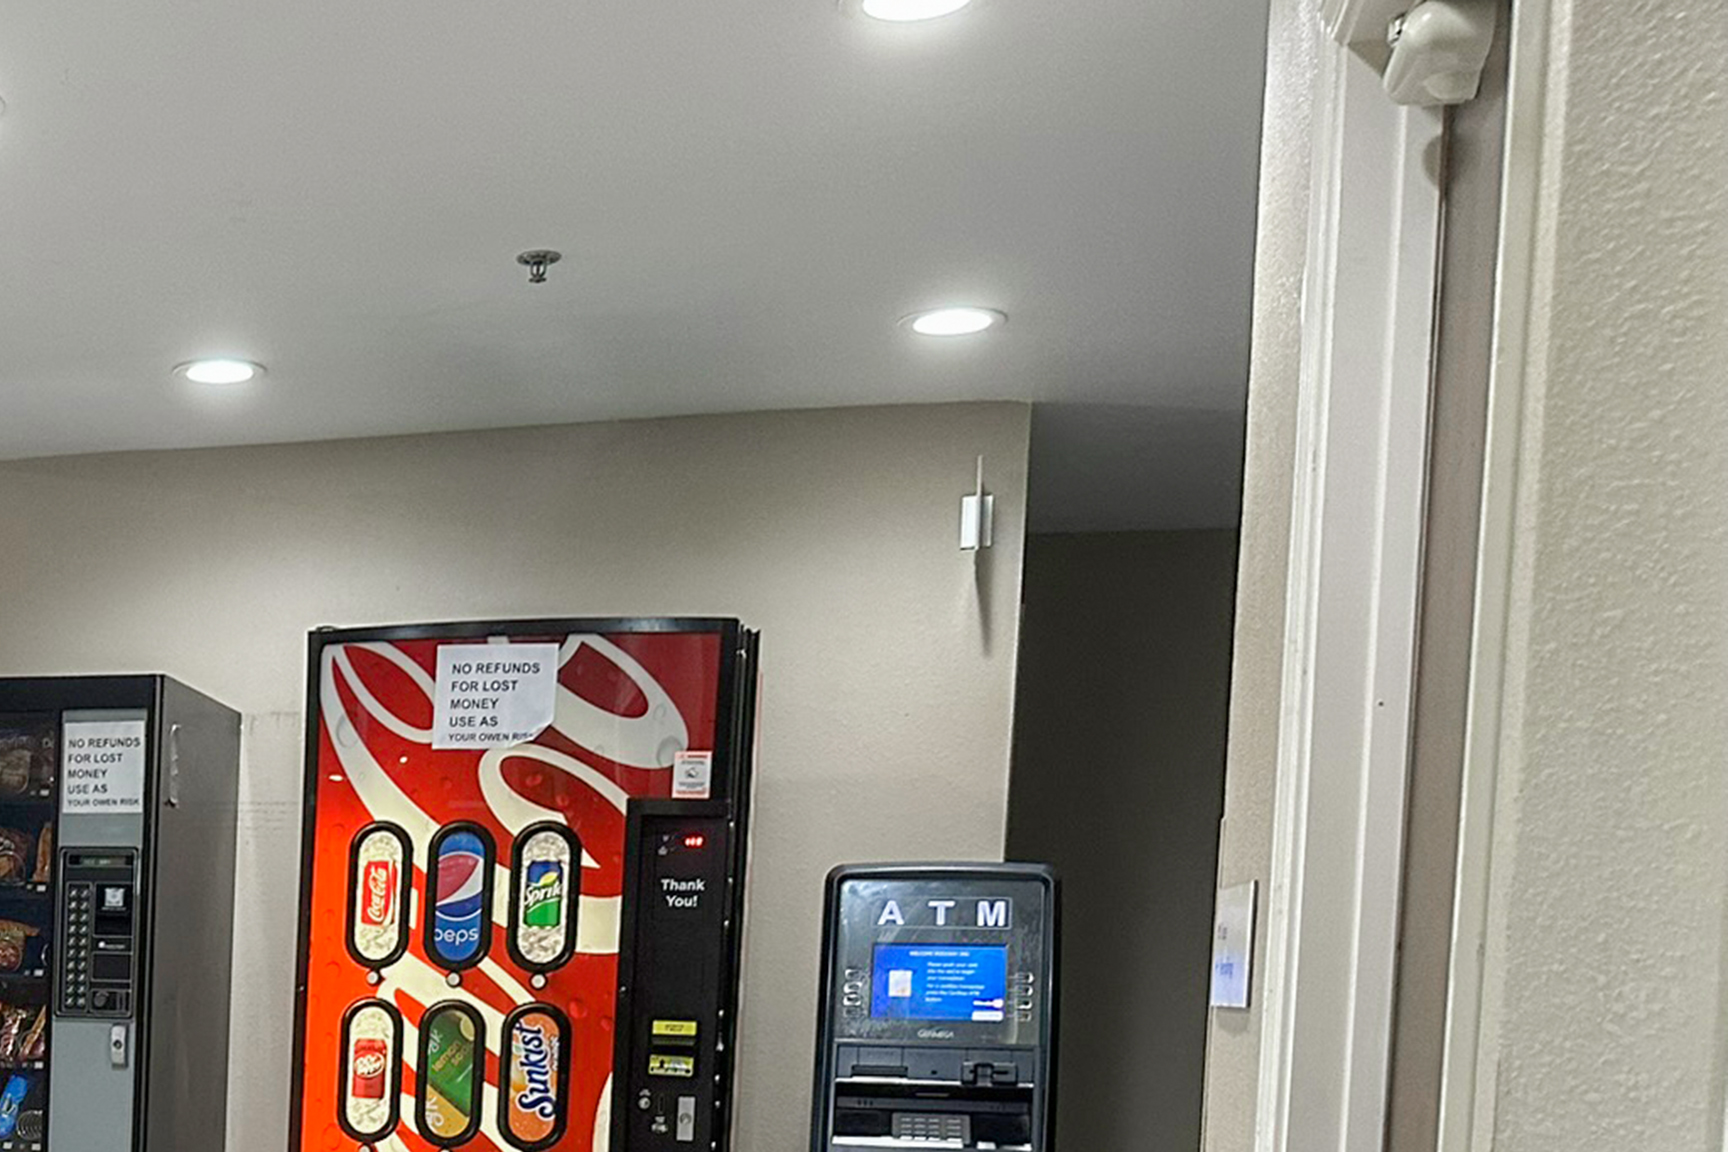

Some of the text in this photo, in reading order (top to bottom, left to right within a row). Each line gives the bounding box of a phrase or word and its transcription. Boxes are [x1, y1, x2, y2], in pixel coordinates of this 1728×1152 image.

[451, 662, 541, 675] NO REFUNDS
[450, 679, 519, 692] FOR LOST
[449, 697, 500, 710] MONEY
[448, 715, 499, 728] USE AS
[68, 737, 86, 749] NO
[87, 736, 141, 749] REFUNDS
[448, 730, 534, 742] YOUR OWEN RIS
[68, 752, 123, 764] FOR LOST
[68, 767, 108, 780] MONEY
[67, 783, 108, 795] USE AS
[660, 877, 706, 892] Thank
[665, 894, 698, 908] You!
[433, 927, 479, 947] peps
[514, 1018, 557, 1122] Sunkist
